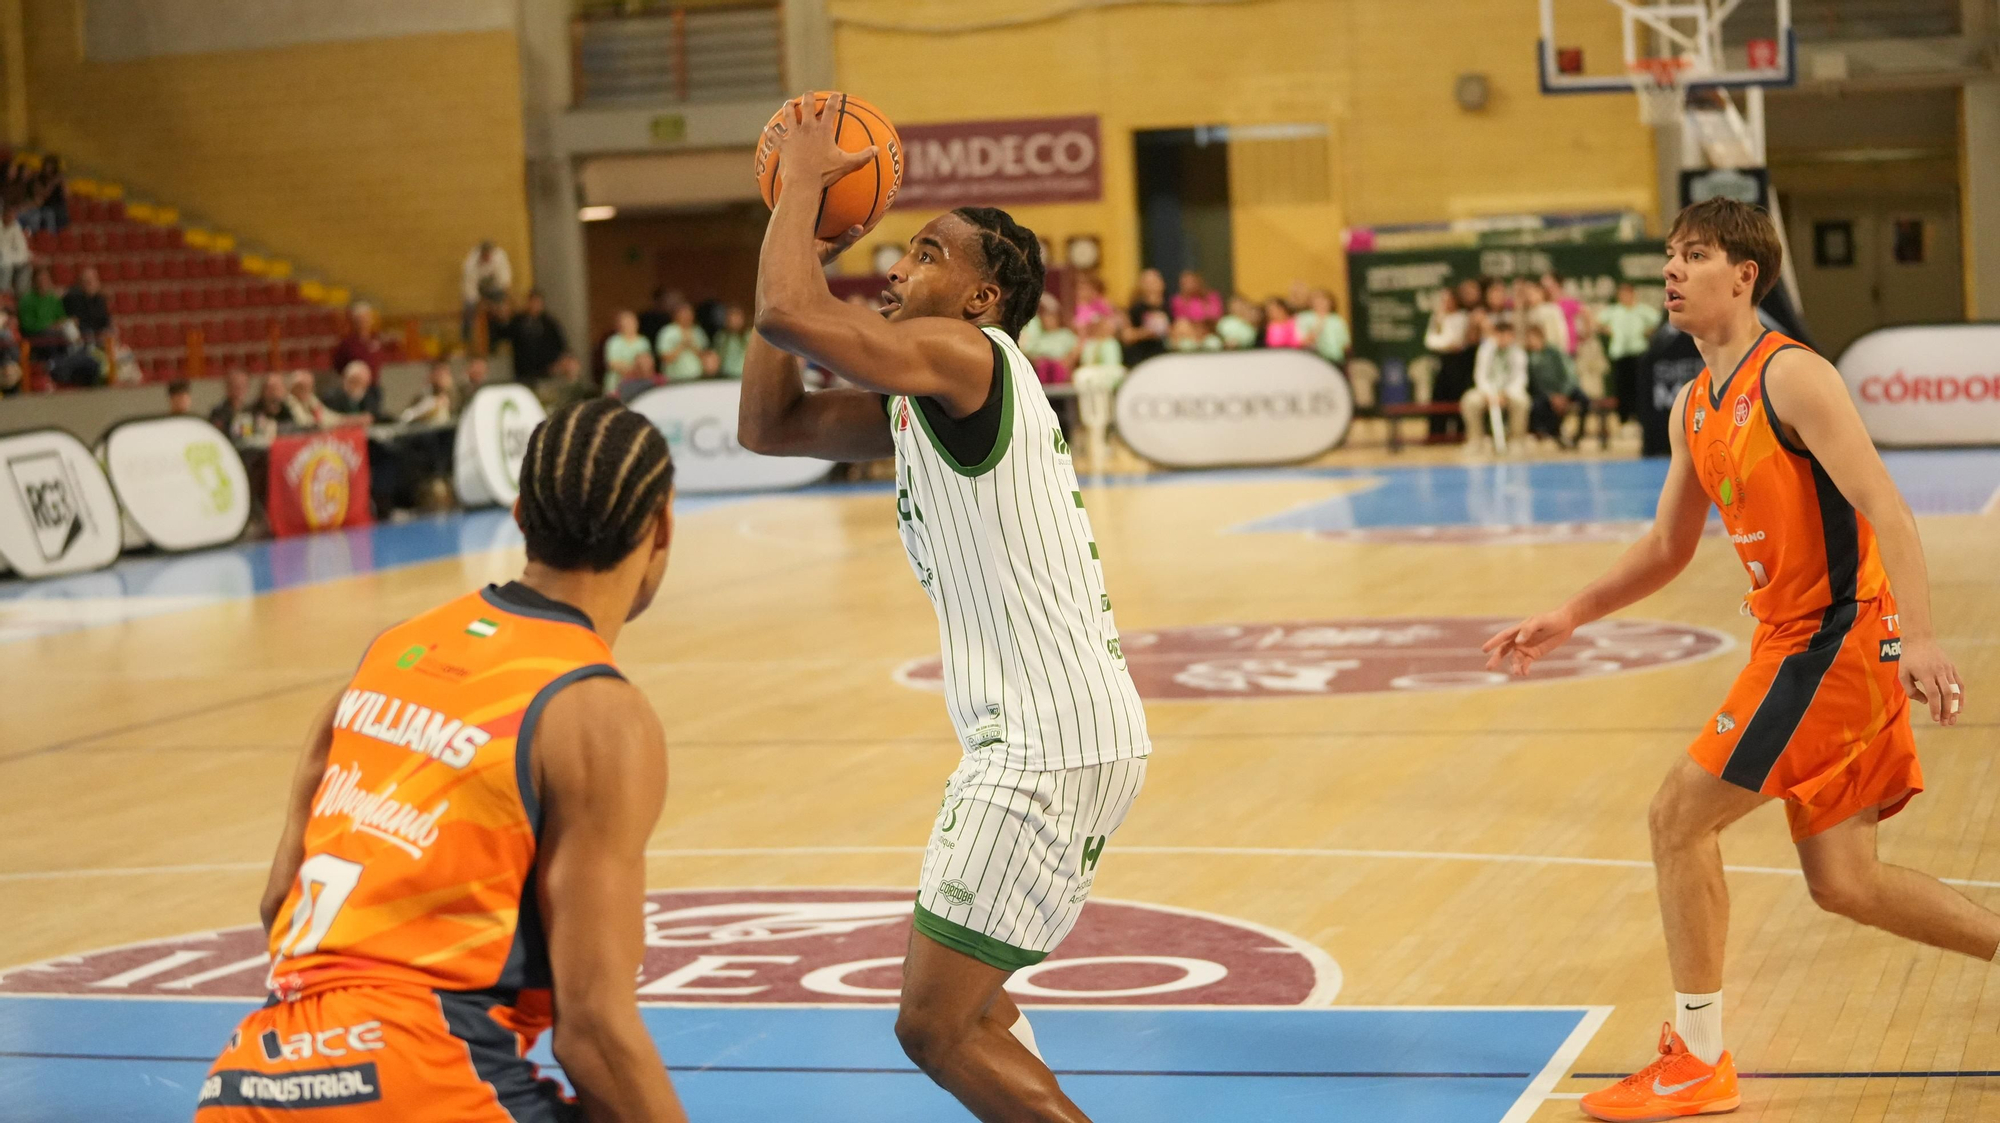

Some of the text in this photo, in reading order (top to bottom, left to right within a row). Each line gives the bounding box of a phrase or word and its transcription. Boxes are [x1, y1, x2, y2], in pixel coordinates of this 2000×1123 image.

[1861, 369, 2000, 403] CÓRDO
[333, 689, 492, 770] WILLIAMS
[314, 761, 450, 850] Wheyland
